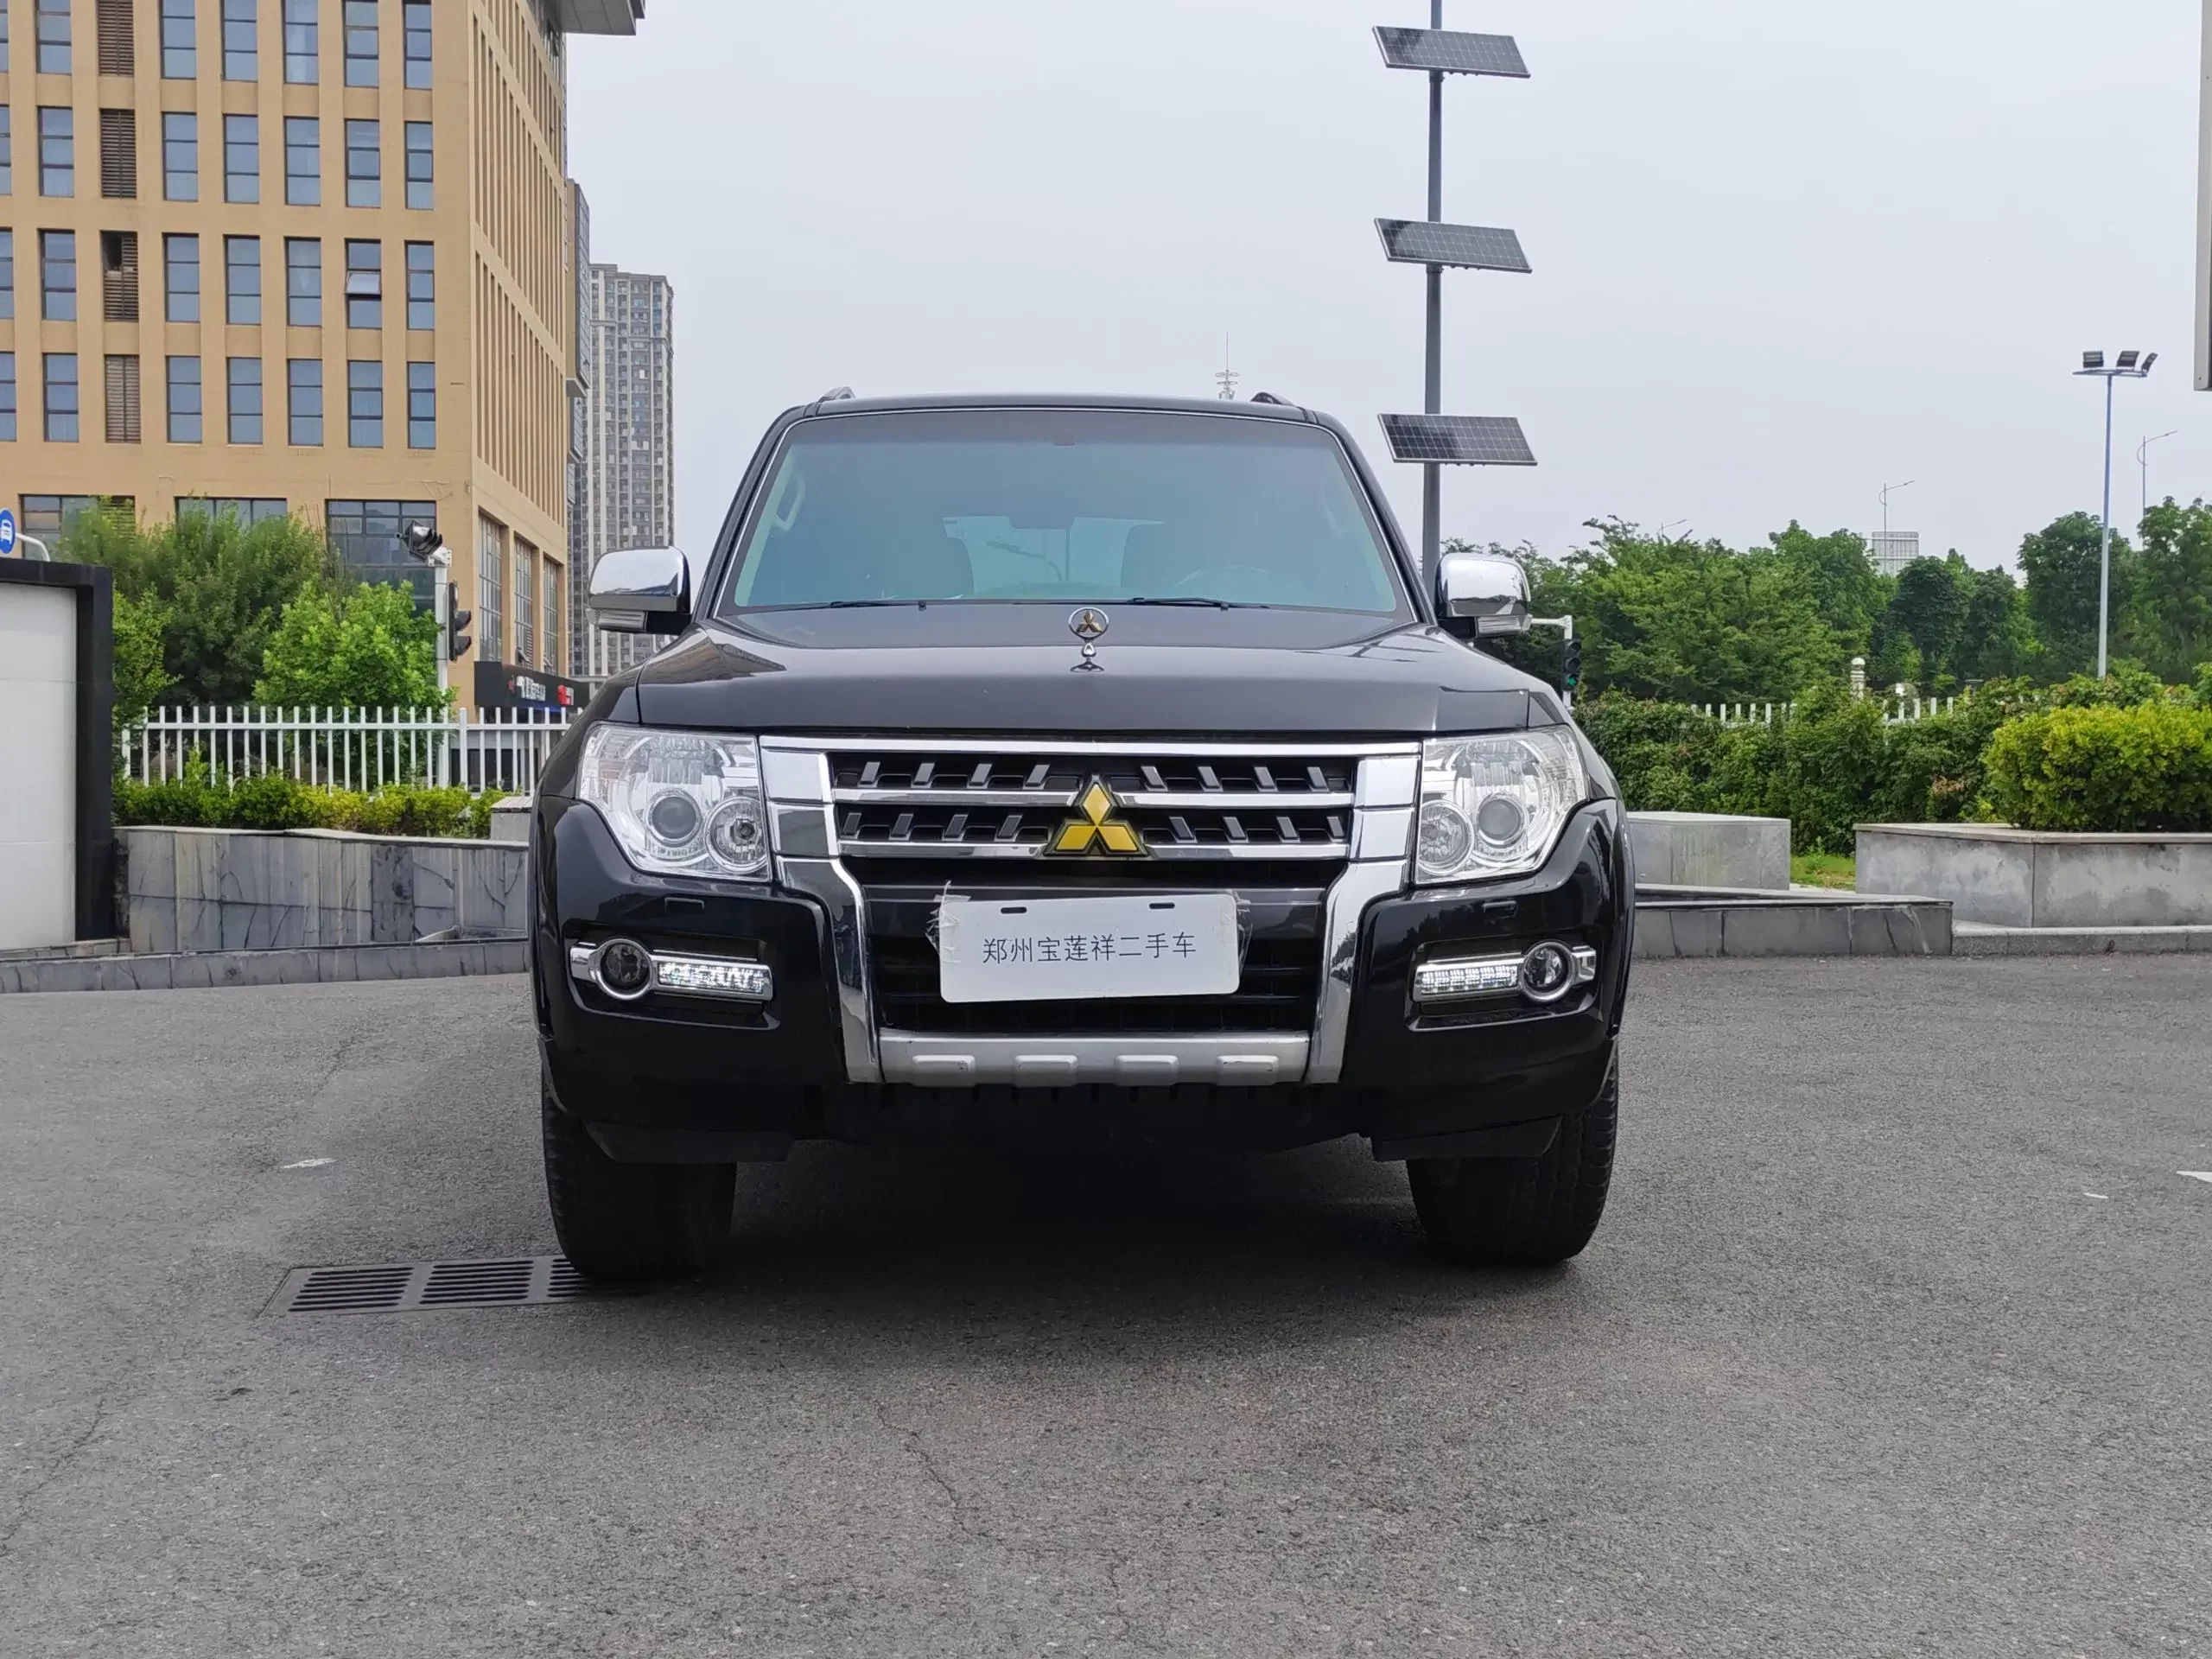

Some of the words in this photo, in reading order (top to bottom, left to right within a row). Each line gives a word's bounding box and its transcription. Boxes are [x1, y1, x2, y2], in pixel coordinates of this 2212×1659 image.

[982, 931, 1197, 964] 郑州宝莲祥二手车
